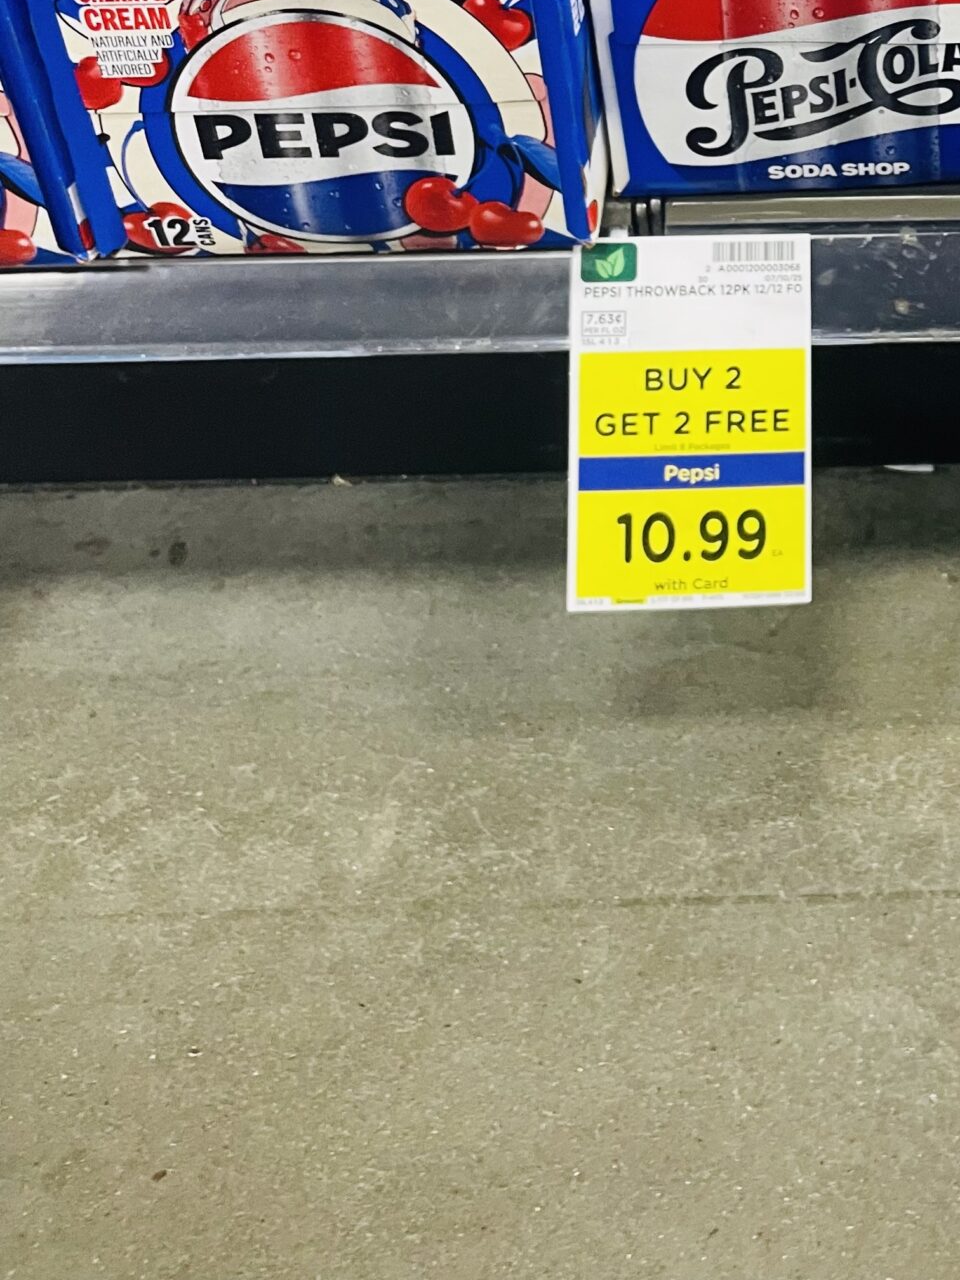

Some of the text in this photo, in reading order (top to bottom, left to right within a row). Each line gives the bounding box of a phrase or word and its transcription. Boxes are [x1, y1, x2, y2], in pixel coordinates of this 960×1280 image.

[84, 7, 172, 31] CREAM
[91, 35, 172, 48] NATURALLY AND
[96, 50, 159, 62] ARTIFICIALLY
[100, 64, 151, 76] FLAVORED
[192, 110, 456, 160] PEPSI
[768, 162, 910, 178] SODA SHOP
[149, 220, 193, 247] 12
[195, 218, 215, 246] CANS
[584, 287, 621, 298] PEPSI
[627, 285, 716, 297] THROWBACK
[721, 285, 750, 296] 12PK
[755, 284, 783, 294] 12/12
[645, 367, 741, 391] BUY 2
[596, 409, 789, 436] GET 2 FREE
[664, 465, 720, 484] Pepsi
[617, 510, 766, 563] 10.99
[654, 578, 728, 591] with Card
